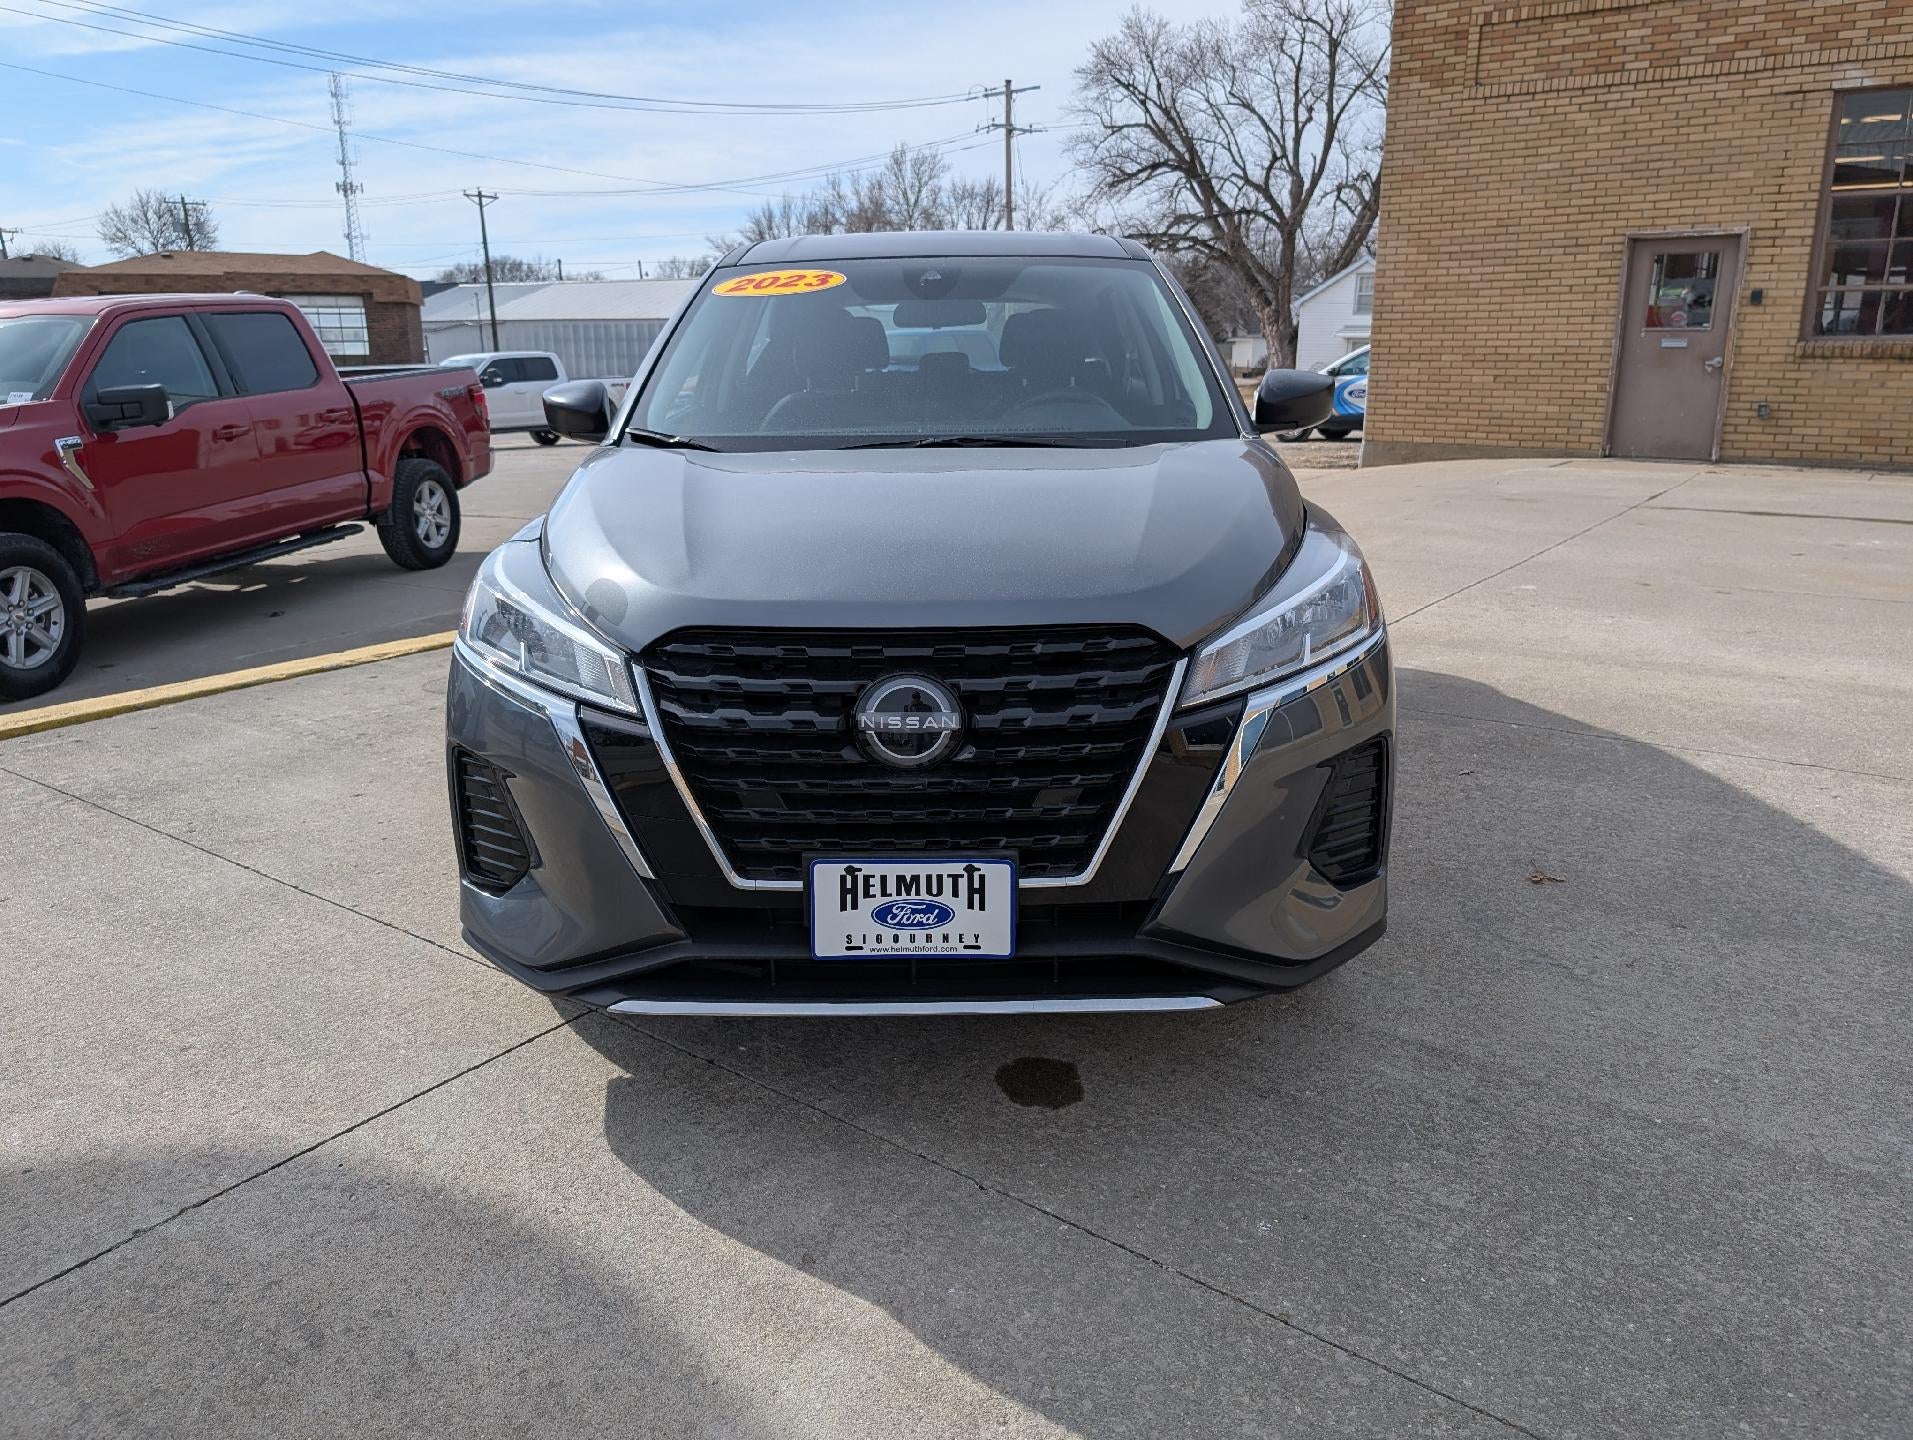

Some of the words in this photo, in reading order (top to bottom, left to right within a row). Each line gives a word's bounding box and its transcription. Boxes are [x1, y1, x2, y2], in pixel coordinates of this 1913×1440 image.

[724, 273, 834, 293] 2023
[860, 715, 956, 729] NISSAN
[839, 864, 986, 912] HELMUTH
[886, 903, 939, 925] Ford
[845, 933, 980, 945] SIGOURNEY
[869, 945, 958, 954] www.helmuthford.com
